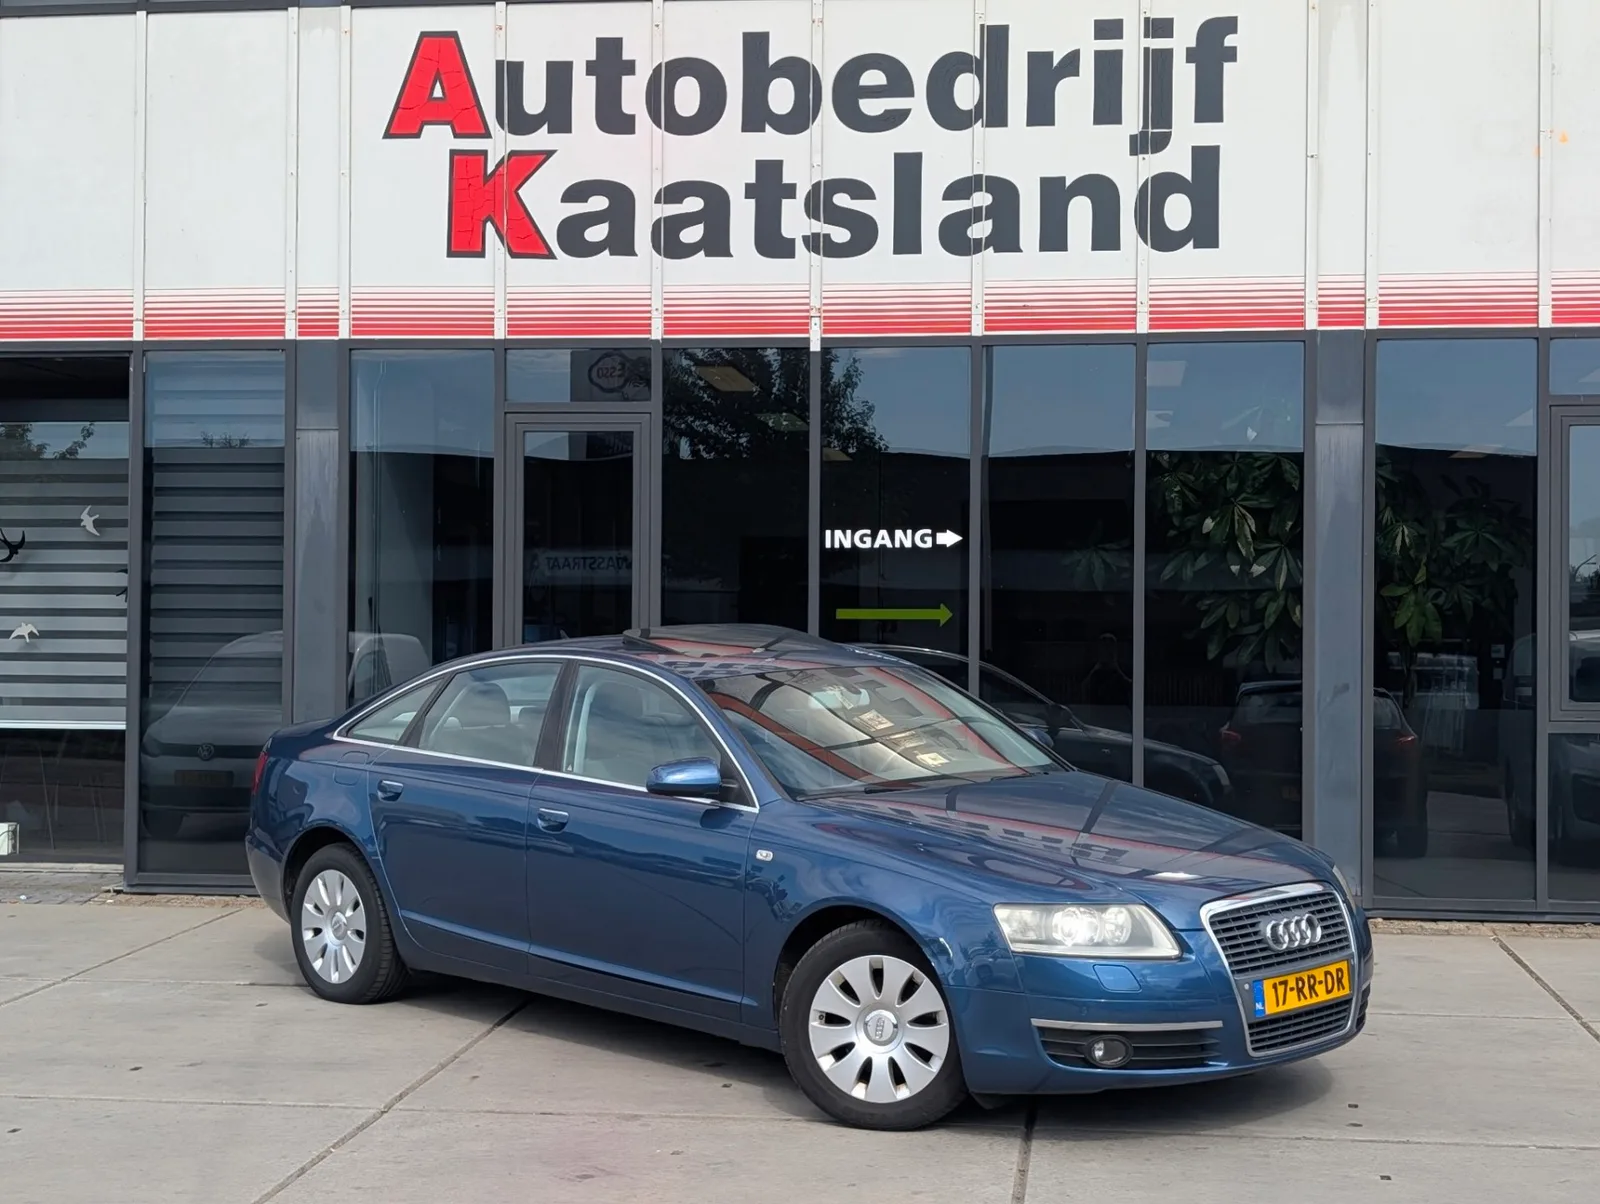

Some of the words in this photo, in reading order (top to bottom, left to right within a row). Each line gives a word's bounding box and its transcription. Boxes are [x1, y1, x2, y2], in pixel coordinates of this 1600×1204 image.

[382, 16, 1238, 156] Autobedrijf
[446, 145, 1220, 260] Kaatsland
[825, 529, 932, 548] INGANG
[1272, 967, 1346, 1008] 17-RR-DR
